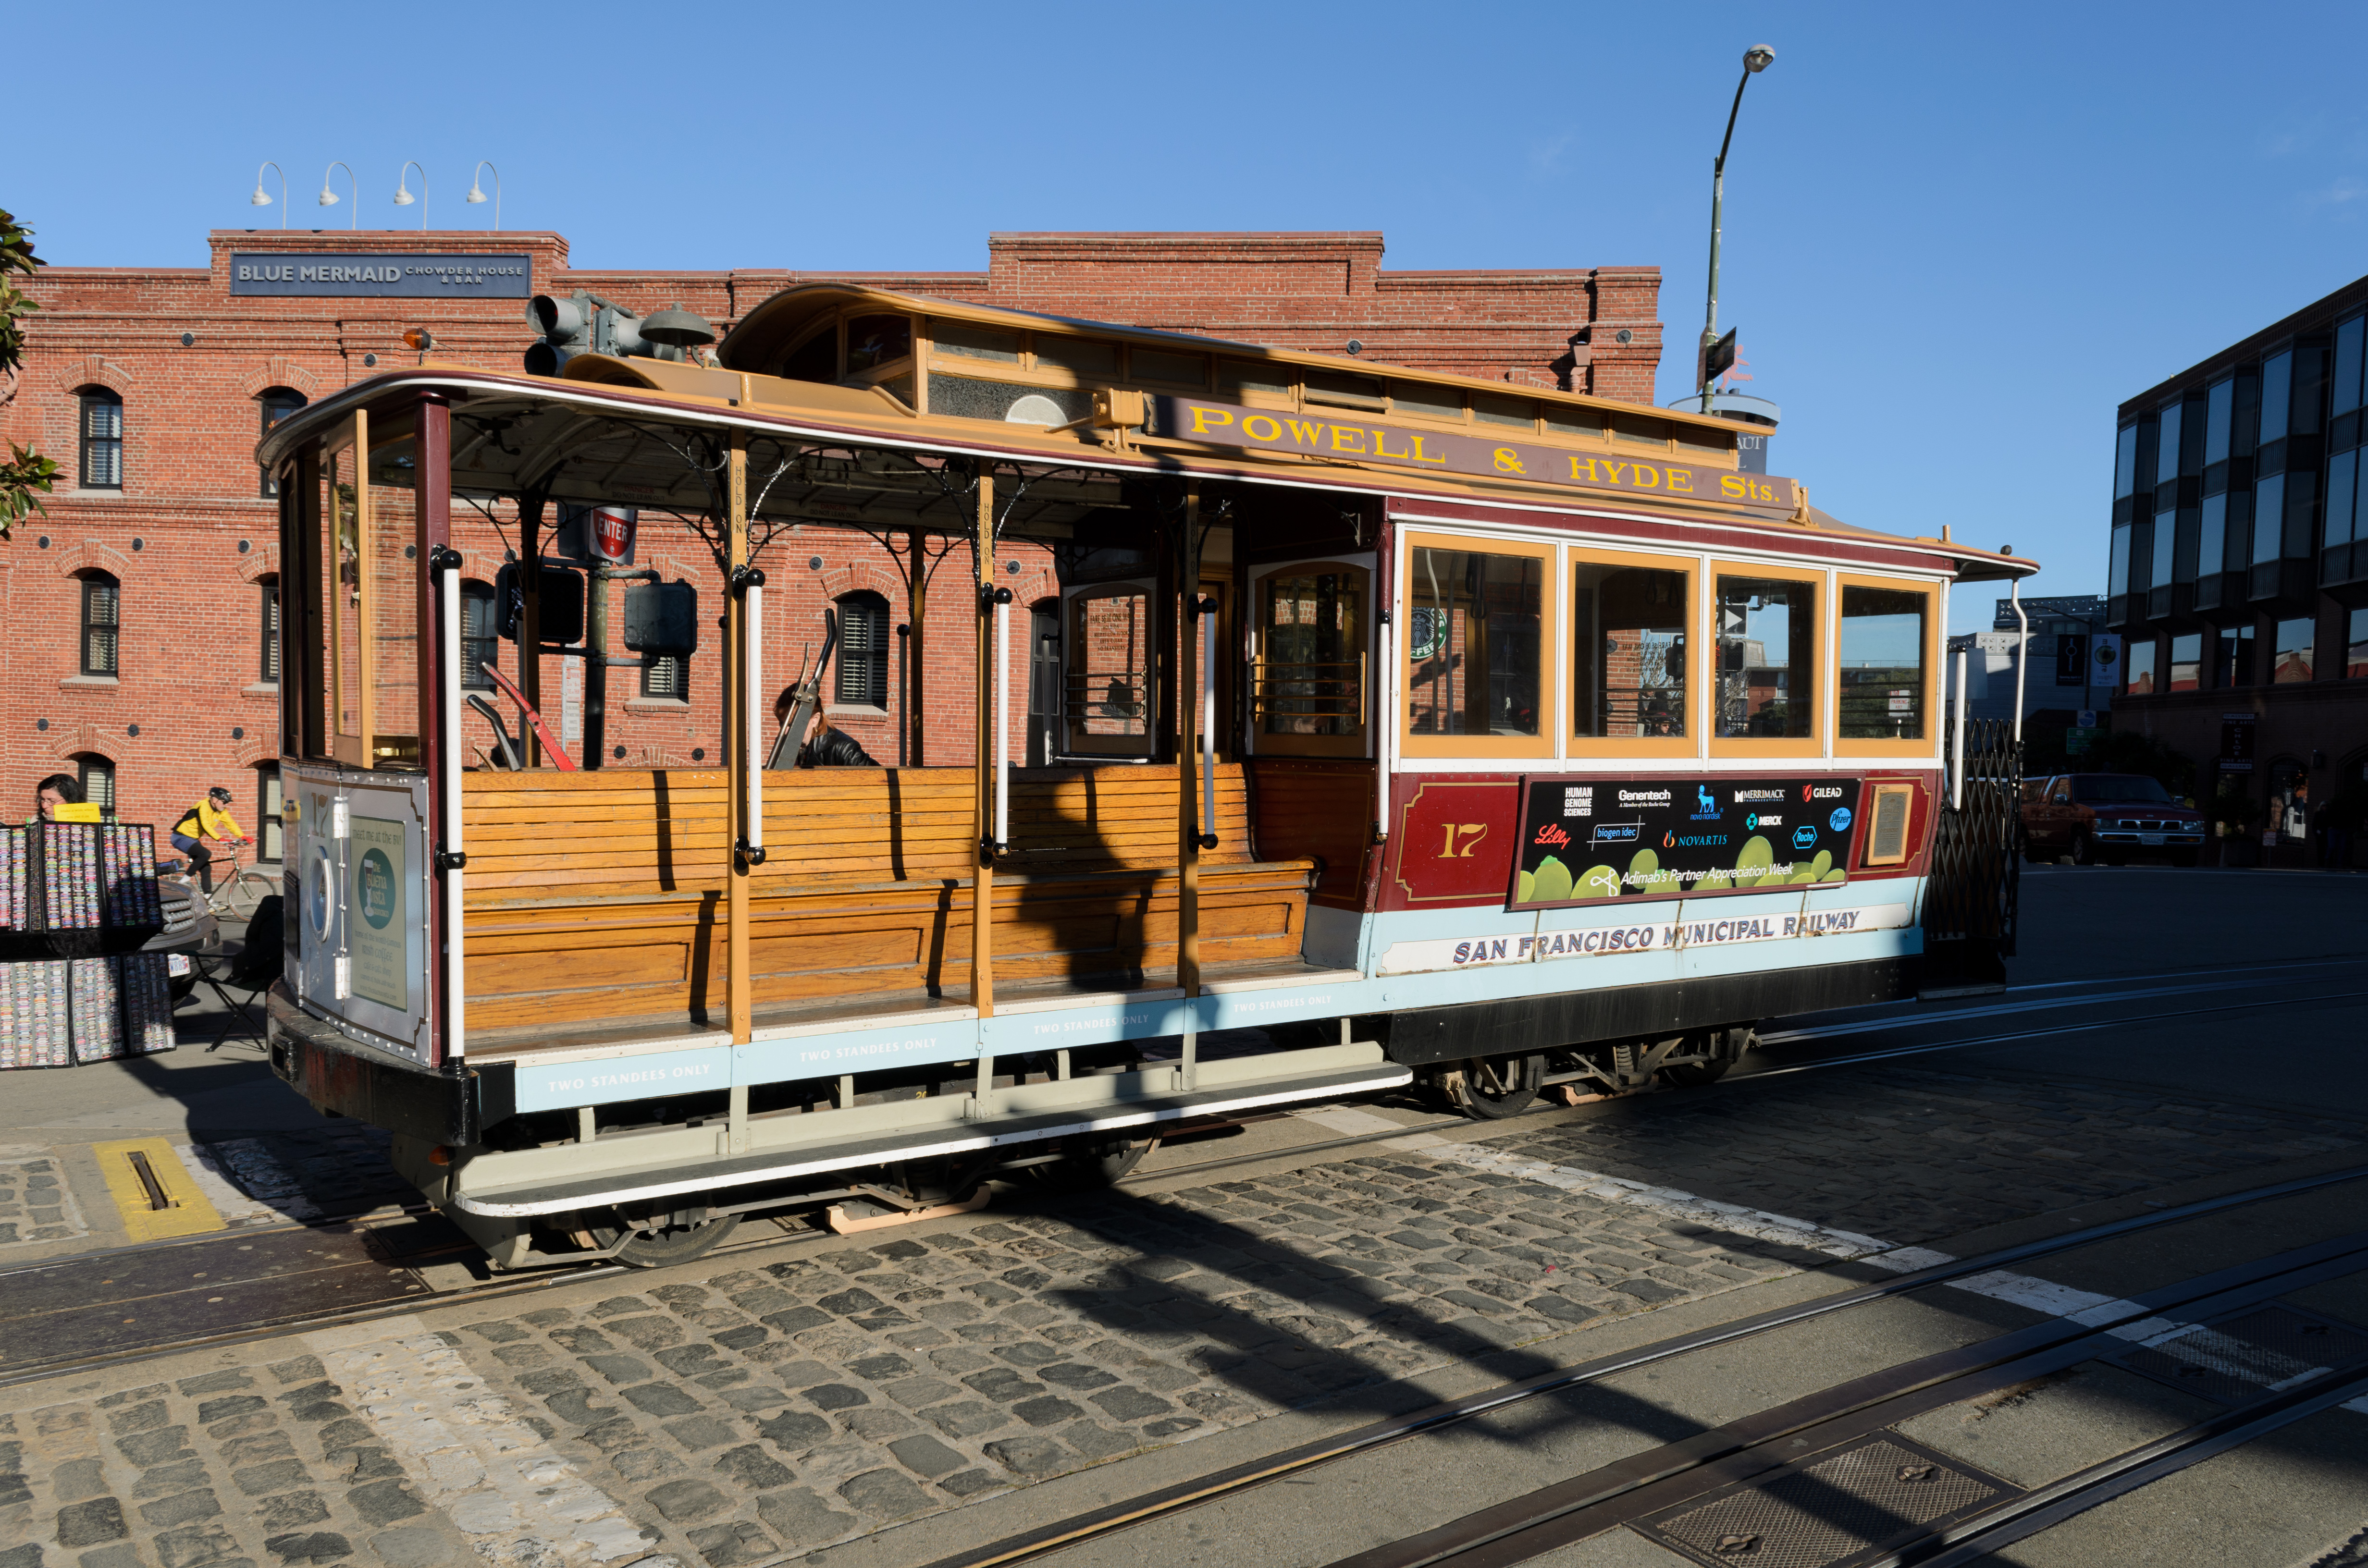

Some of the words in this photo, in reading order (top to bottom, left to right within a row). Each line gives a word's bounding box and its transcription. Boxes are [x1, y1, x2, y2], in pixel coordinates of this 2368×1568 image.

[239, 266, 294, 281] BLUE
[300, 267, 401, 282] MERMAID
[405, 267, 473, 275] CHOWDER
[478, 267, 523, 276] HOUSE
[441, 275, 449, 284] &
[454, 275, 482, 284] BAR
[1189, 406, 1445, 464] POWELL
[1493, 447, 1527, 474] &
[1568, 456, 1693, 493] HYDE
[1720, 475, 1780, 502] Sts.
[624, 485, 654, 494] DANGER
[598, 516, 628, 542] ENTER
[736, 514, 742, 533] ON
[985, 547, 989, 565] ON
[1191, 561, 1196, 575] ON
[1090, 615, 1100, 624] FARE
[1112, 613, 1122, 622] ONE
[2233, 728, 2242, 756] CHLOE
[1565, 787, 1592, 797] HUMAN
[1618, 789, 1671, 801] Genentech
[1743, 789, 1784, 798] MERRIMACK
[1813, 787, 1842, 798] GILEAD
[1565, 798, 1592, 808] GENOME
[311, 792, 328, 838] 17
[1564, 808, 1591, 816] SCIENCES
[1831, 810, 1850, 830] Pfizer
[1759, 816, 1782, 826] MERCK
[352, 829, 365, 840] meet
[366, 831, 374, 842] me
[375, 832, 381, 842] at
[382, 831, 392, 845] the
[1437, 823, 1488, 858] 17
[1534, 823, 1571, 849] Lilly
[1597, 828, 1620, 839] biogen
[1622, 827, 1636, 836] idec
[1677, 834, 1727, 846] NOVARTIS
[1797, 832, 1813, 843] Roche
[1620, 870, 1667, 885] Adimab's
[1669, 869, 1706, 882] Partner
[1707, 866, 1766, 883] Appreciation
[1769, 862, 1794, 875] Week
[1453, 939, 1508, 964] SAN
[1517, 927, 1654, 957] FRANCISCO
[1662, 919, 1775, 946] MUNICIPAL
[1783, 911, 1861, 936] RAILWAY
[1233, 1003, 1256, 1013] TWO
[1259, 998, 1305, 1010] STANDEES
[1308, 995, 1332, 1005] ONLY
[1034, 1024, 1060, 1035] TWO
[1064, 1017, 1117, 1032] STANDEES
[1121, 1014, 1149, 1025] ONLY
[800, 1049, 831, 1063] TWO
[836, 1041, 900, 1058] STANDEES
[904, 1037, 937, 1051] ONLY
[548, 1077, 585, 1092] TWO
[591, 1068, 666, 1088] STANDEES
[672, 1063, 711, 1079] ONLY
